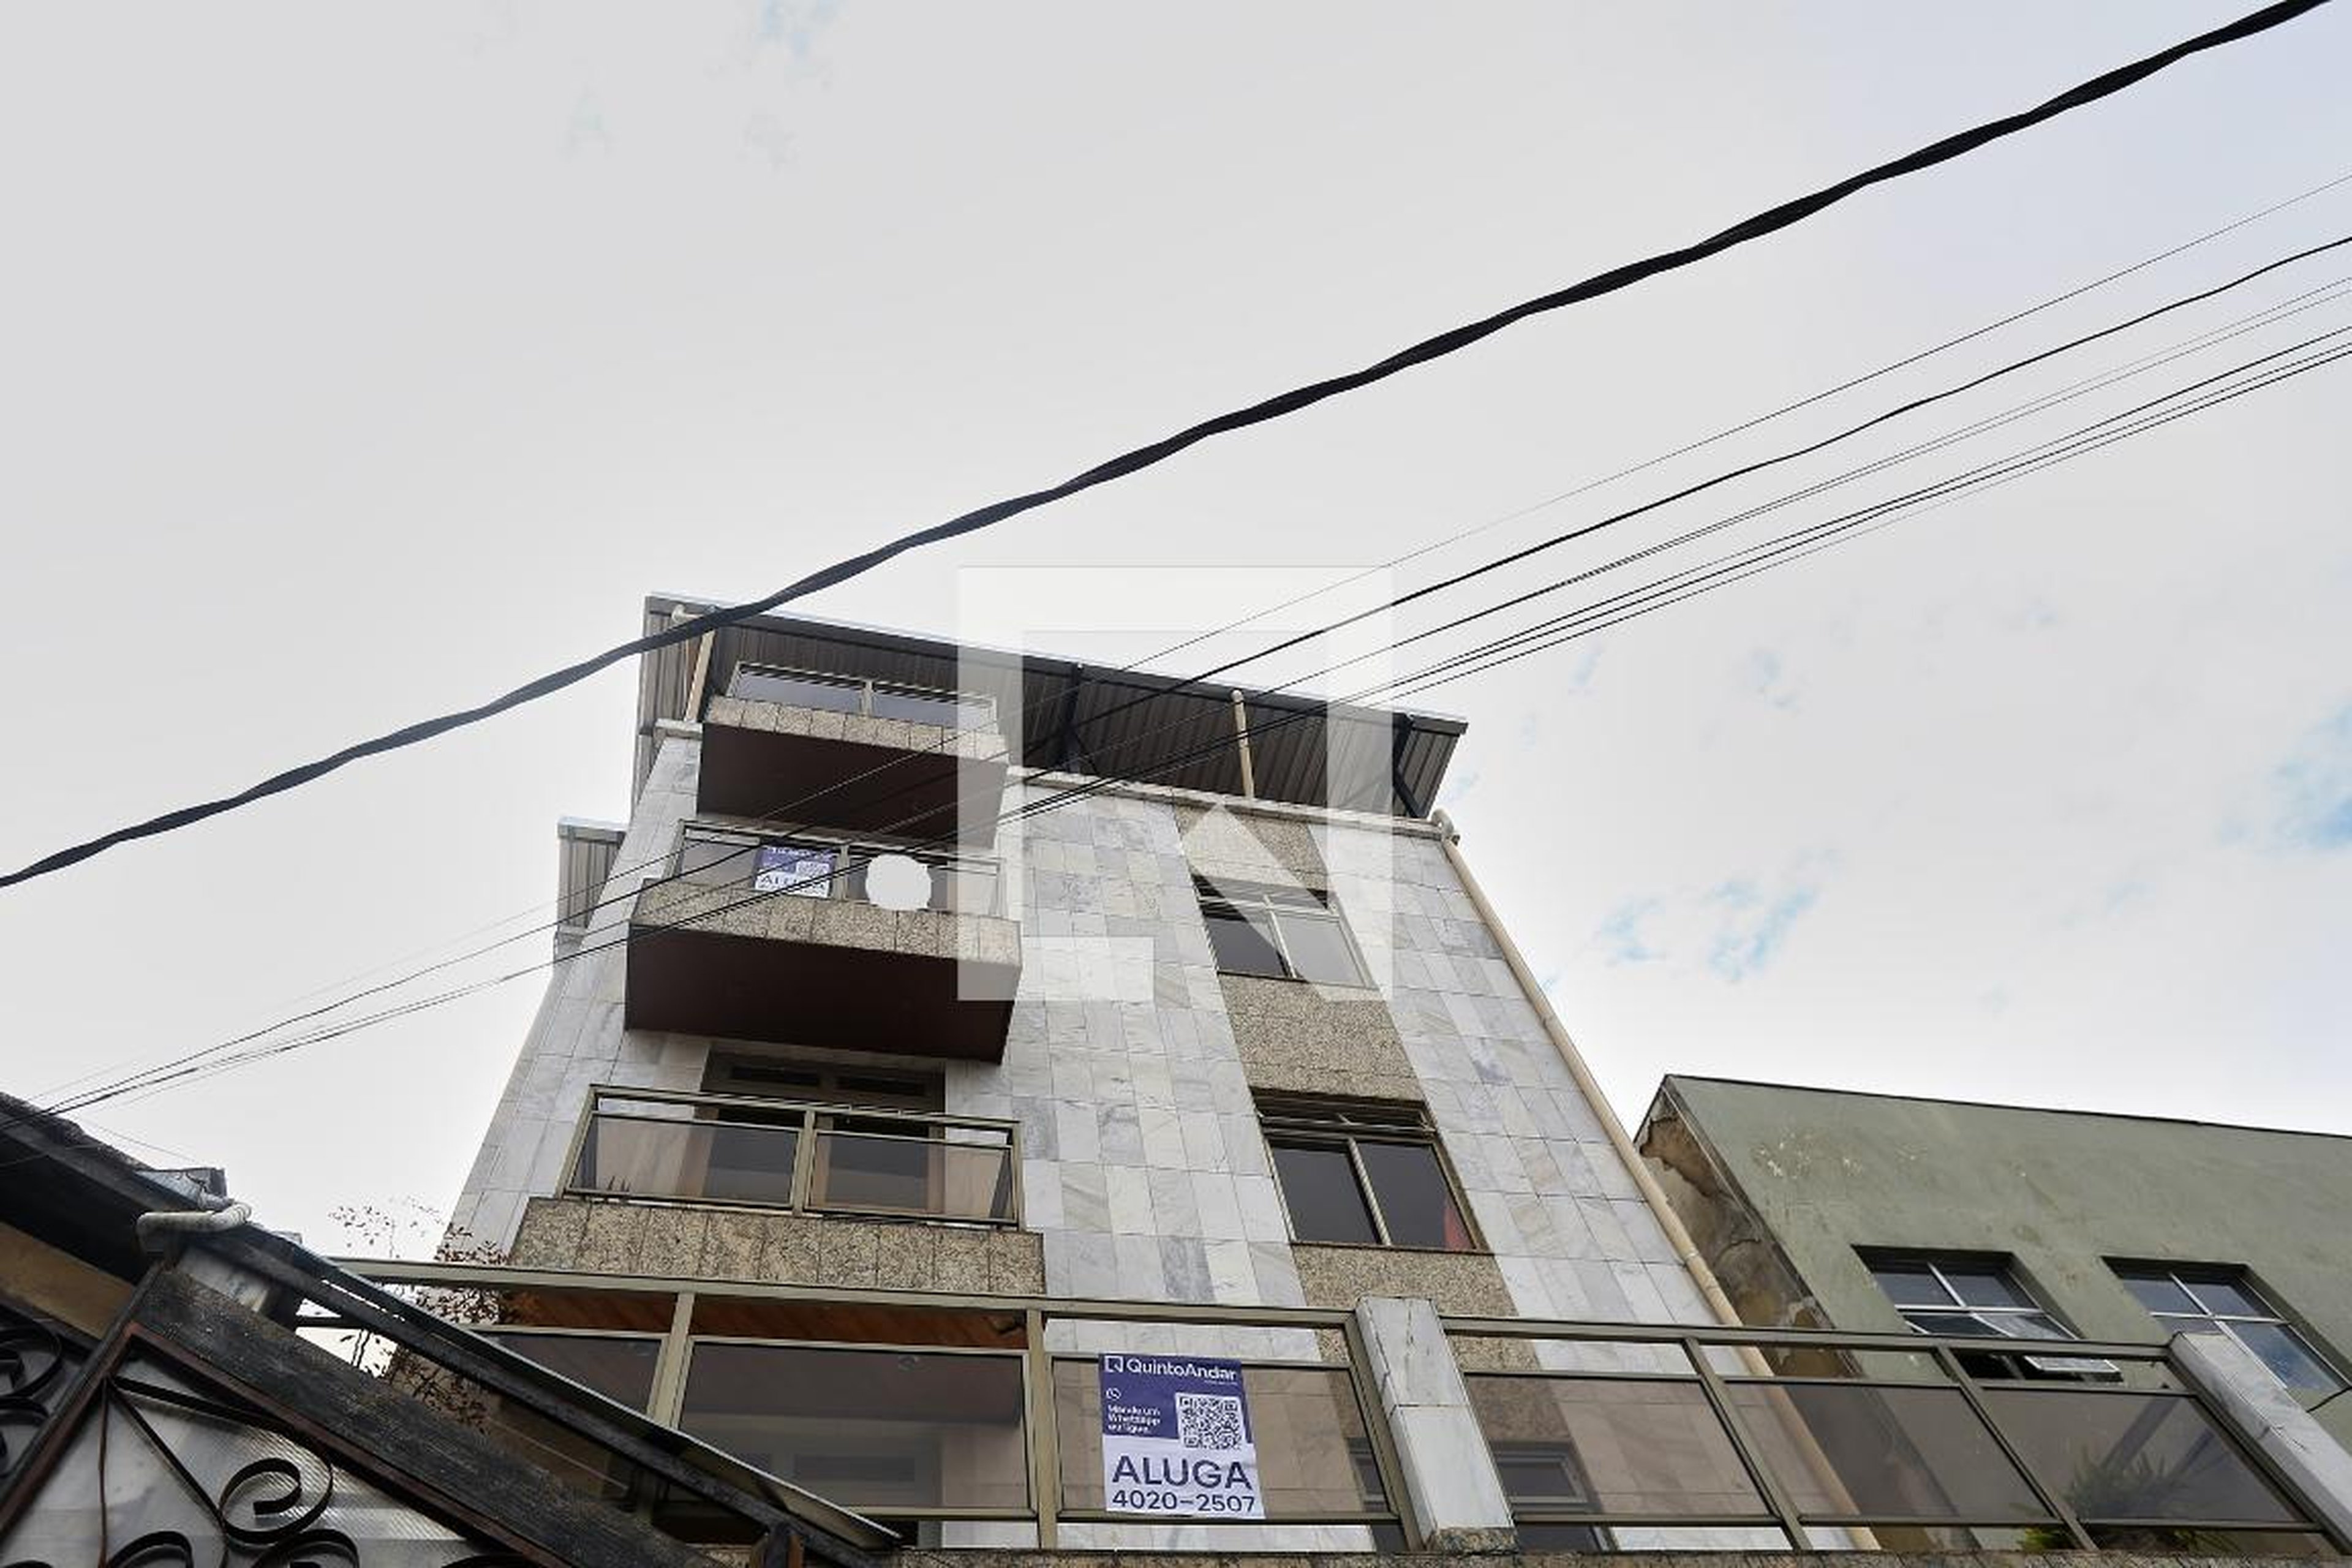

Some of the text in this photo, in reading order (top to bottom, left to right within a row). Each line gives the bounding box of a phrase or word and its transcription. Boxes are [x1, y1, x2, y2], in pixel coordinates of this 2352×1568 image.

[1126, 1358, 1237, 1381] QuintoAndar
[1112, 1455, 1253, 1490] ALUGA
[1112, 1489, 1255, 1512] 4020-2507
